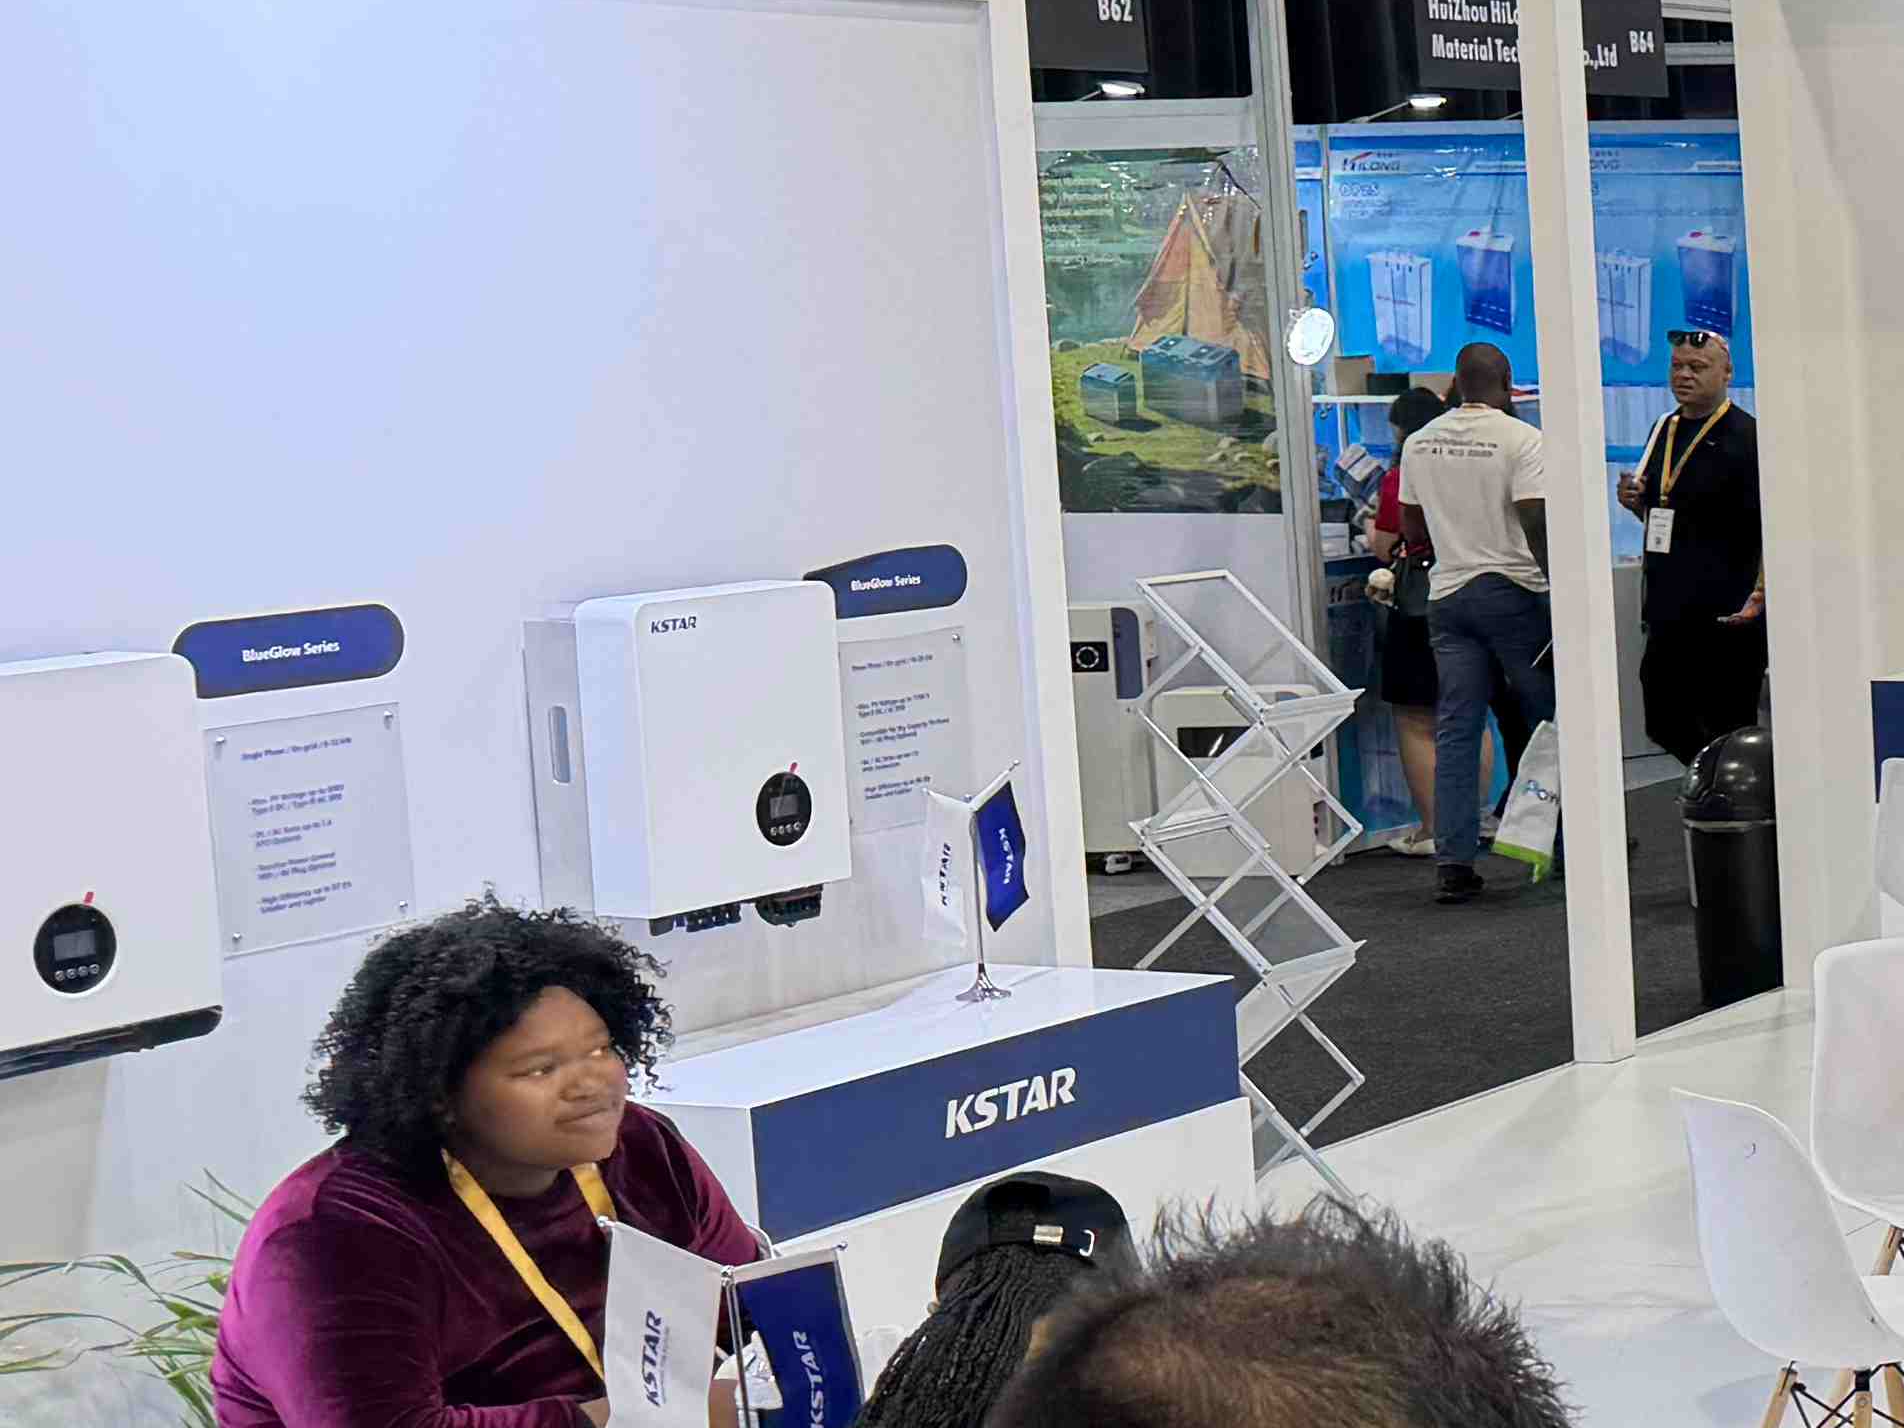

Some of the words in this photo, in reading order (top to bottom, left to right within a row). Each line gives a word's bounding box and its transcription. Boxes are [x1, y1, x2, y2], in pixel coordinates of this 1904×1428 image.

[1432, 34, 1493, 62] Material
[1629, 30, 1655, 54] B64
[894, 575, 921, 586] Series
[650, 616, 697, 634] KSTAR
[242, 647, 301, 662] BlueGlow
[303, 640, 341, 656] Series
[945, 1067, 1077, 1139] KSTAR
[642, 1310, 662, 1408] KSTAR
